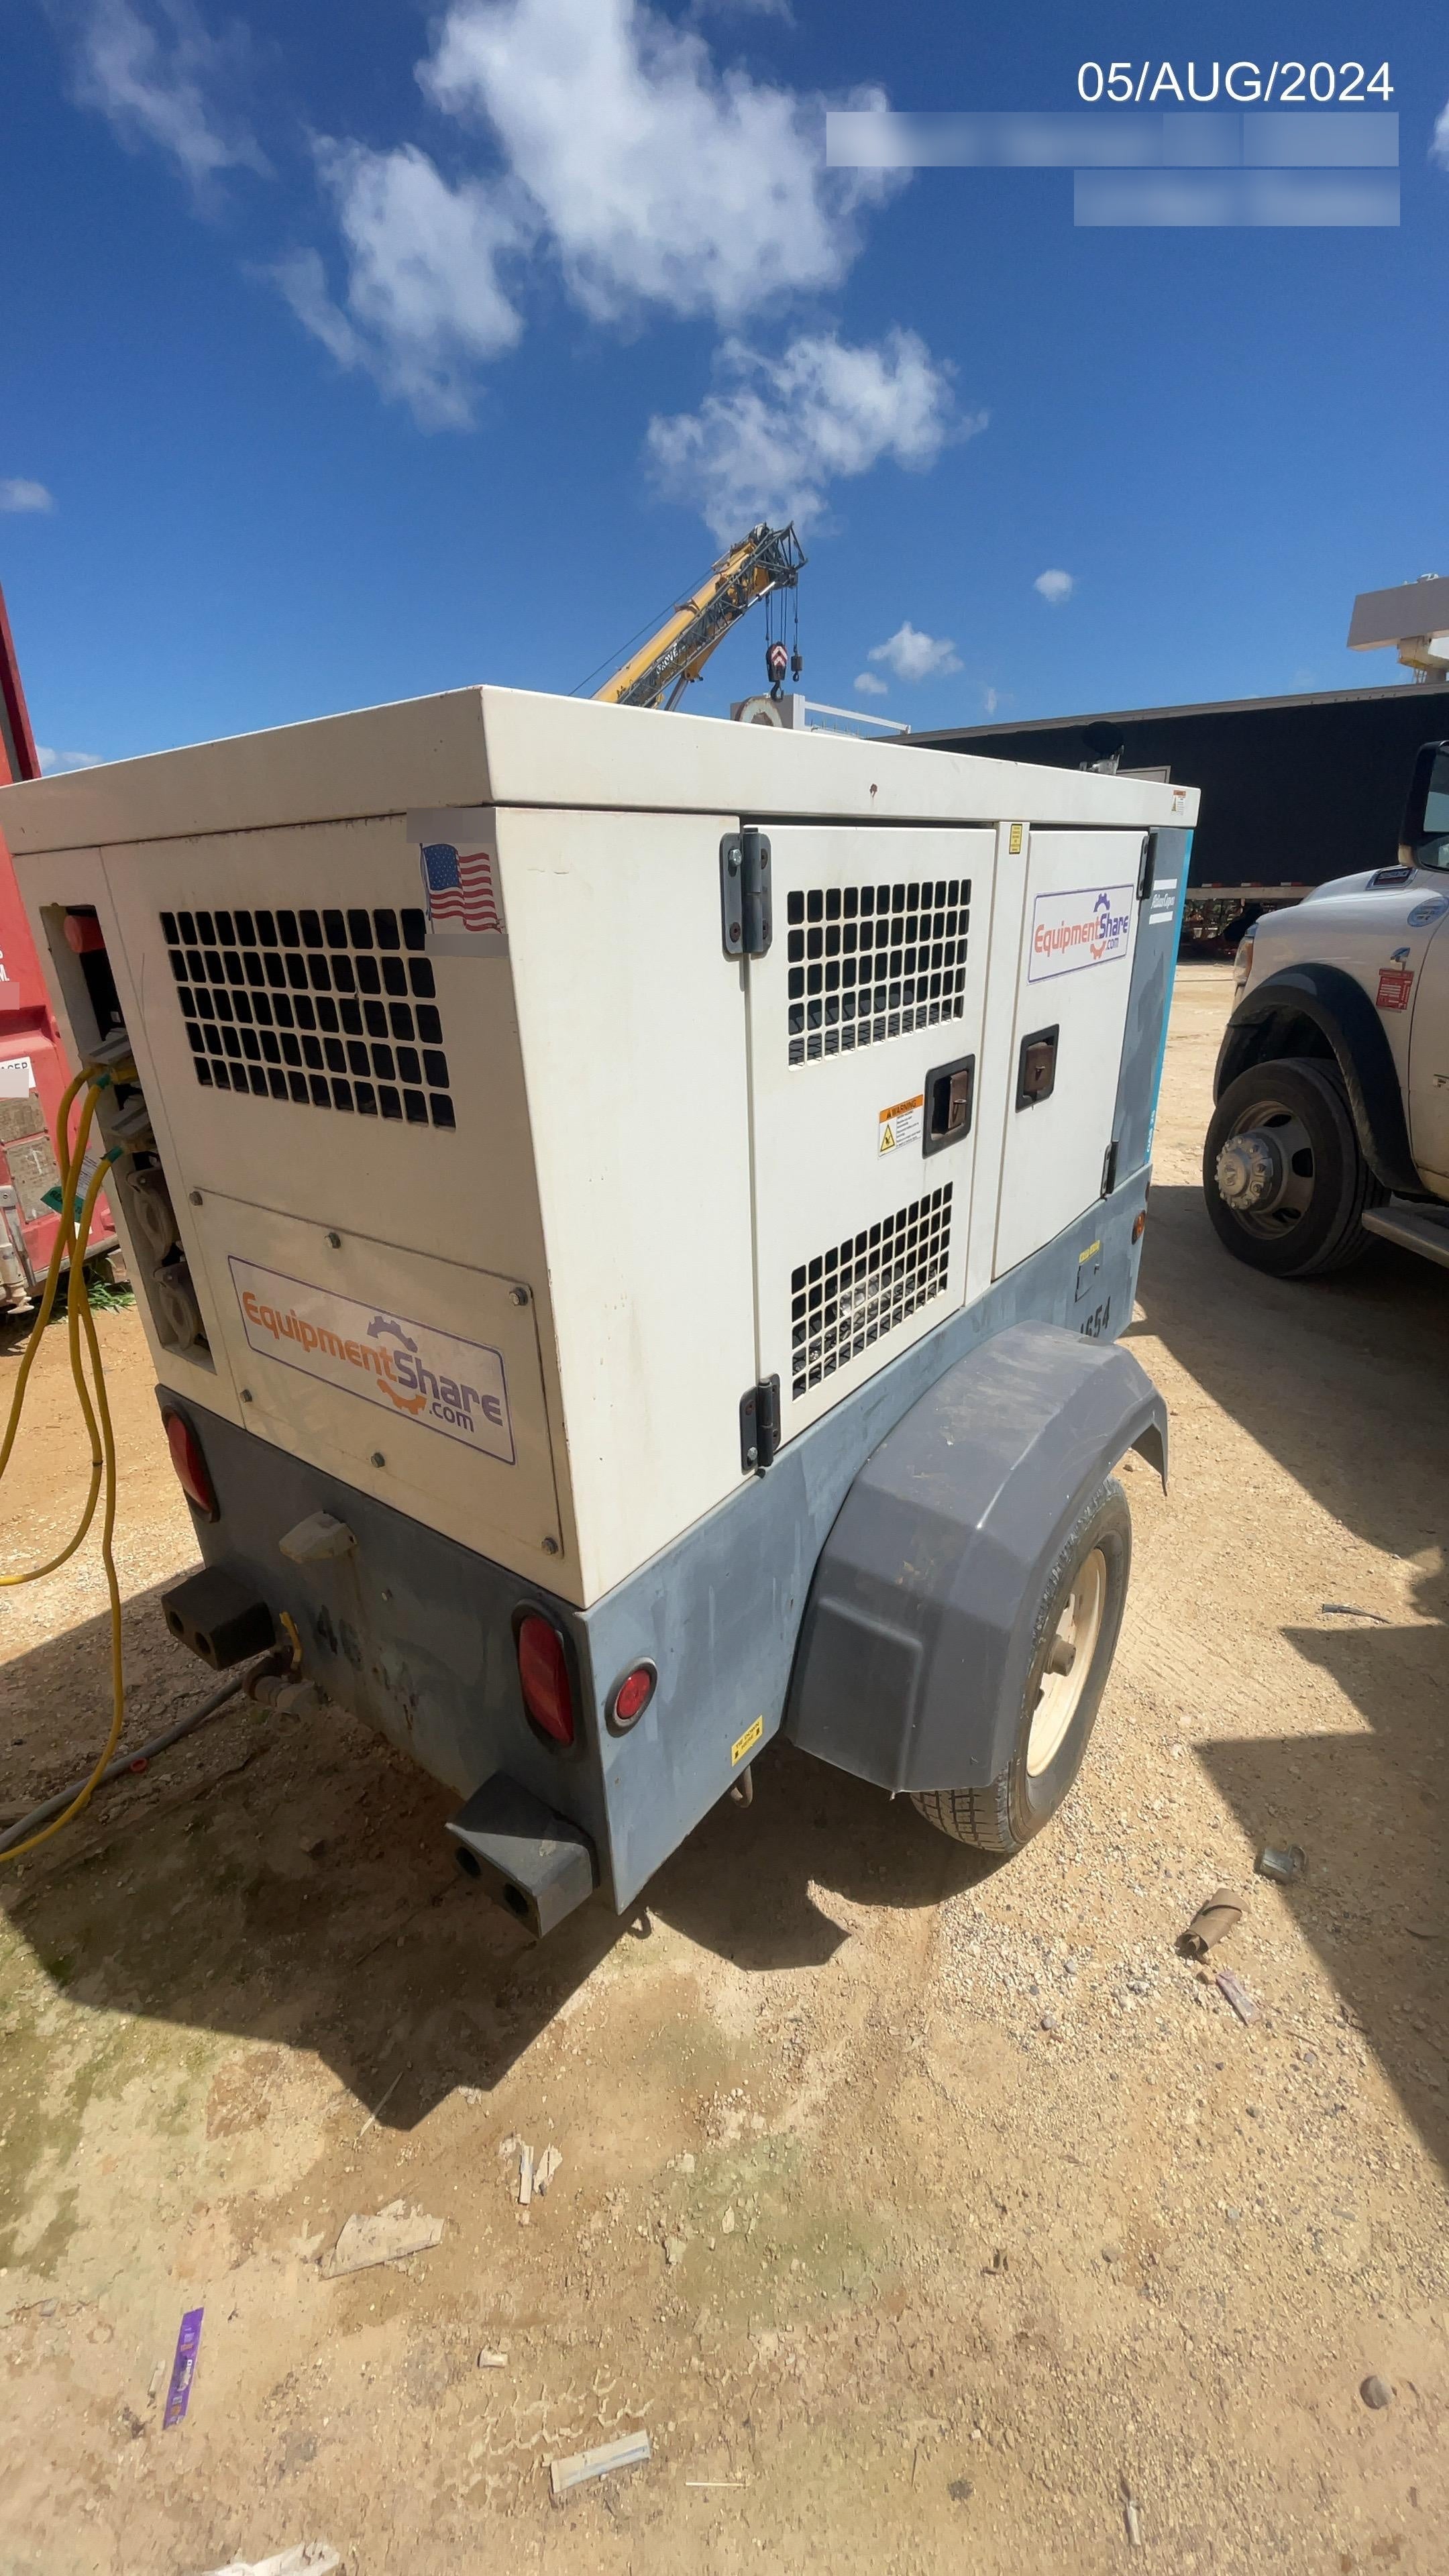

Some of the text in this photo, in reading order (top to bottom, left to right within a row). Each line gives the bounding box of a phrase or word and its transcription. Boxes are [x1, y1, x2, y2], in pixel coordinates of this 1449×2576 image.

[1034, 912, 1129, 958] EquipmentShare
[241, 1291, 503, 1427] EquipmentShare
[429, 1401, 475, 1434] .com
